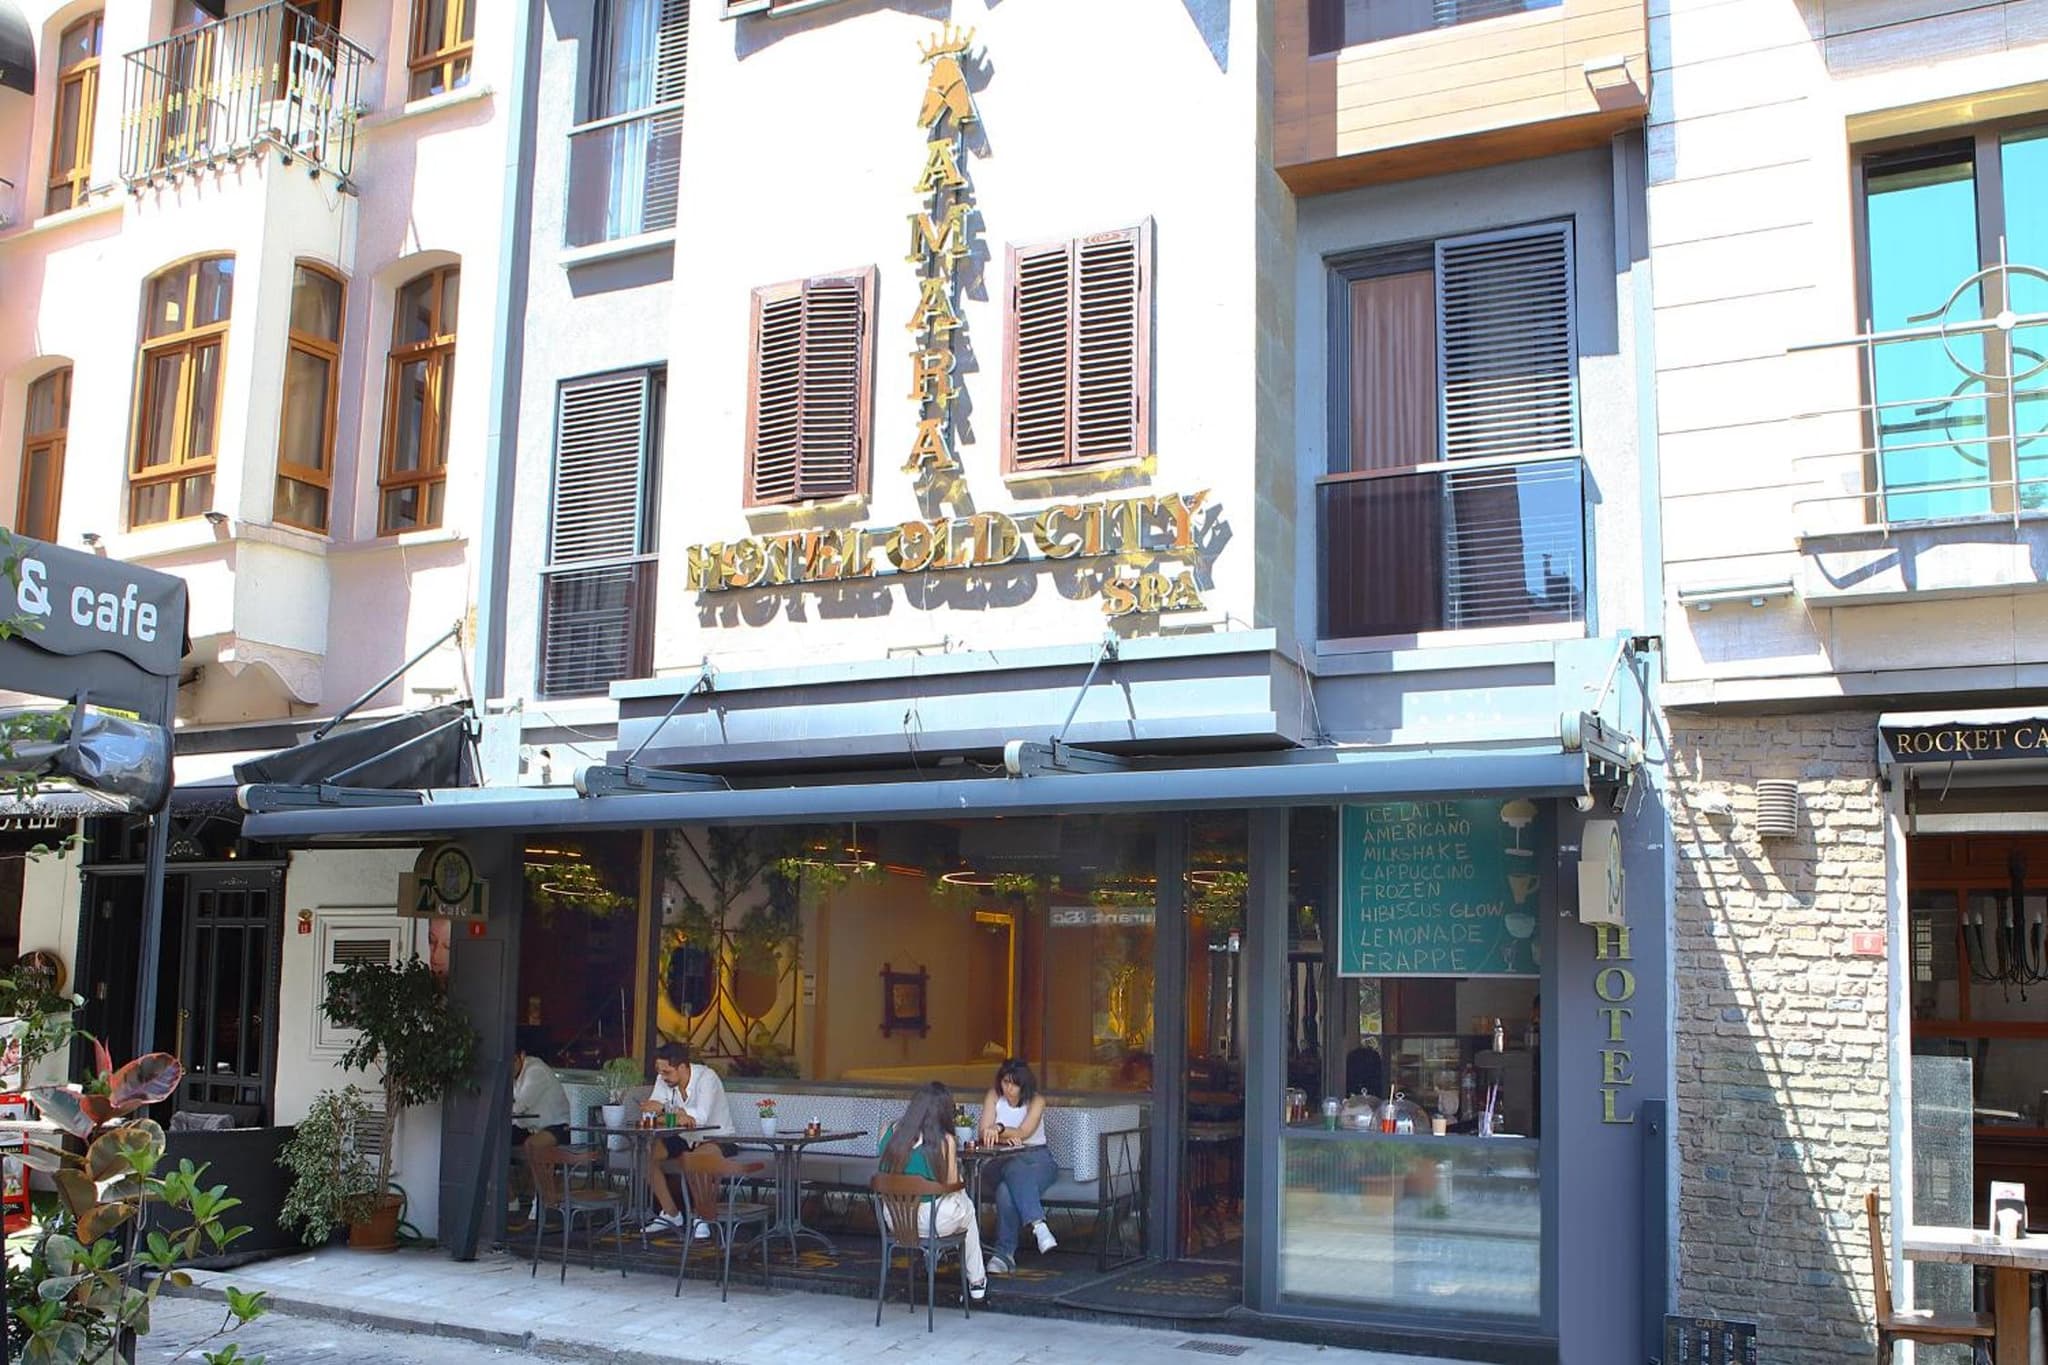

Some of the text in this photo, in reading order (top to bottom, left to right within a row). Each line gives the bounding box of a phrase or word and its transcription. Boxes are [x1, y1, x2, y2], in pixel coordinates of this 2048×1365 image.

[684, 488, 1211, 593] HOTEL OLD CITY
[17, 558, 158, 642] & cafe
[1101, 570, 1207, 615] SPA
[1896, 729, 2006, 754] ROCKET
[1366, 800, 1459, 825] ICE LATTE
[1363, 819, 1471, 843] AMERICANO
[1360, 863, 1474, 881] CAPPUCCINO
[1360, 881, 1440, 903] FROZEN
[1360, 901, 1504, 923] HIBISCUS GLOW
[1360, 923, 1484, 948] LEMONADE
[1361, 949, 1467, 972] FRAPPE
[1595, 925, 1635, 1123] HOTEL
